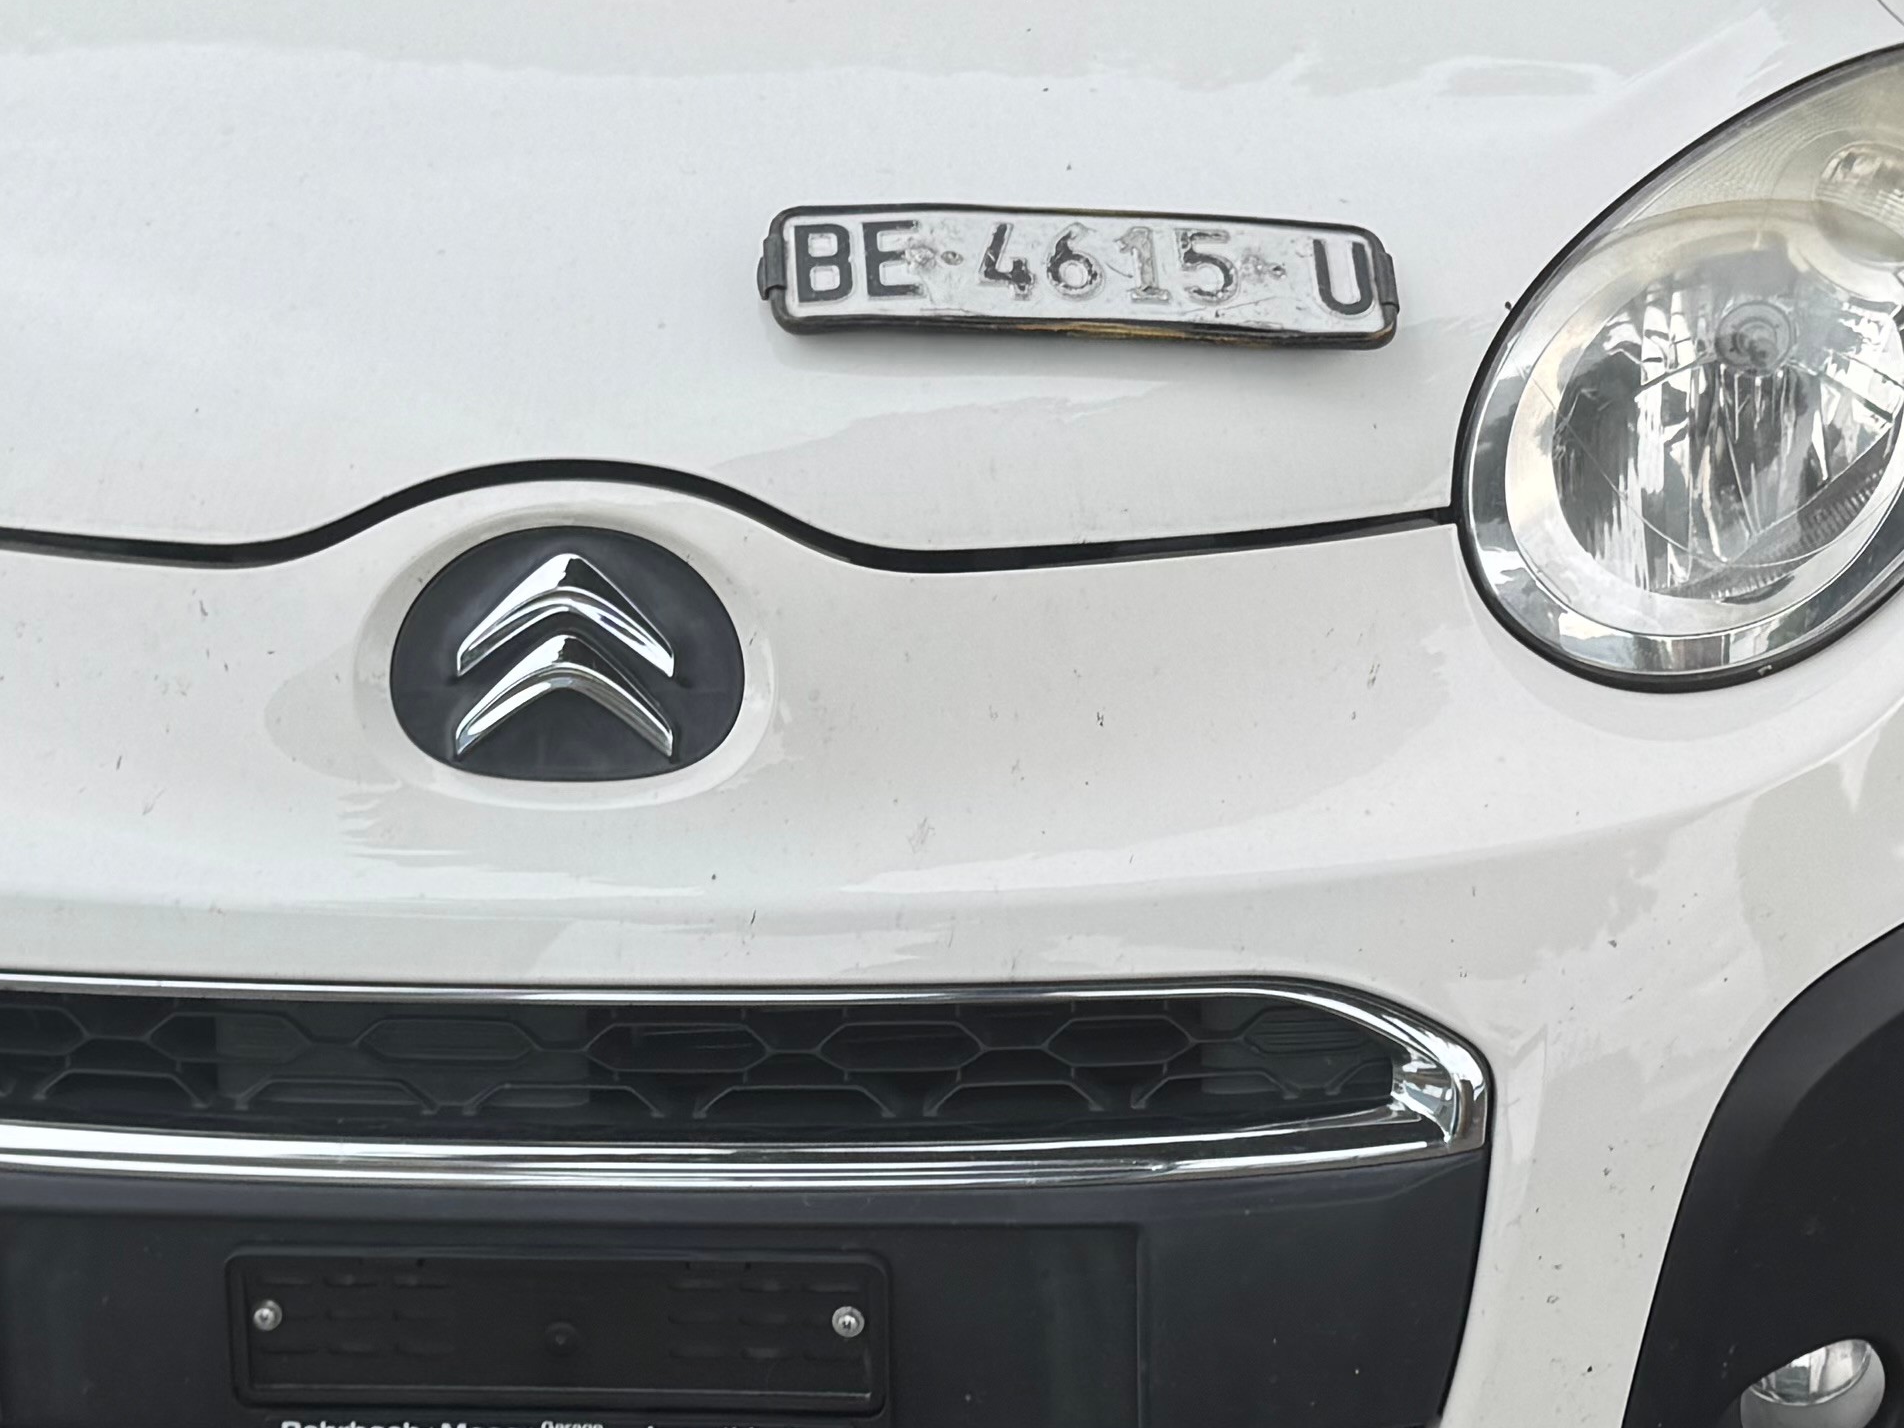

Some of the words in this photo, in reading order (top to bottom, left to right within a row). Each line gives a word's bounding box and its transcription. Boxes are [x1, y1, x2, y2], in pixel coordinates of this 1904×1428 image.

[794, 220, 923, 303] BE
[977, 222, 1238, 305] 4615
[1312, 238, 1377, 316] U
